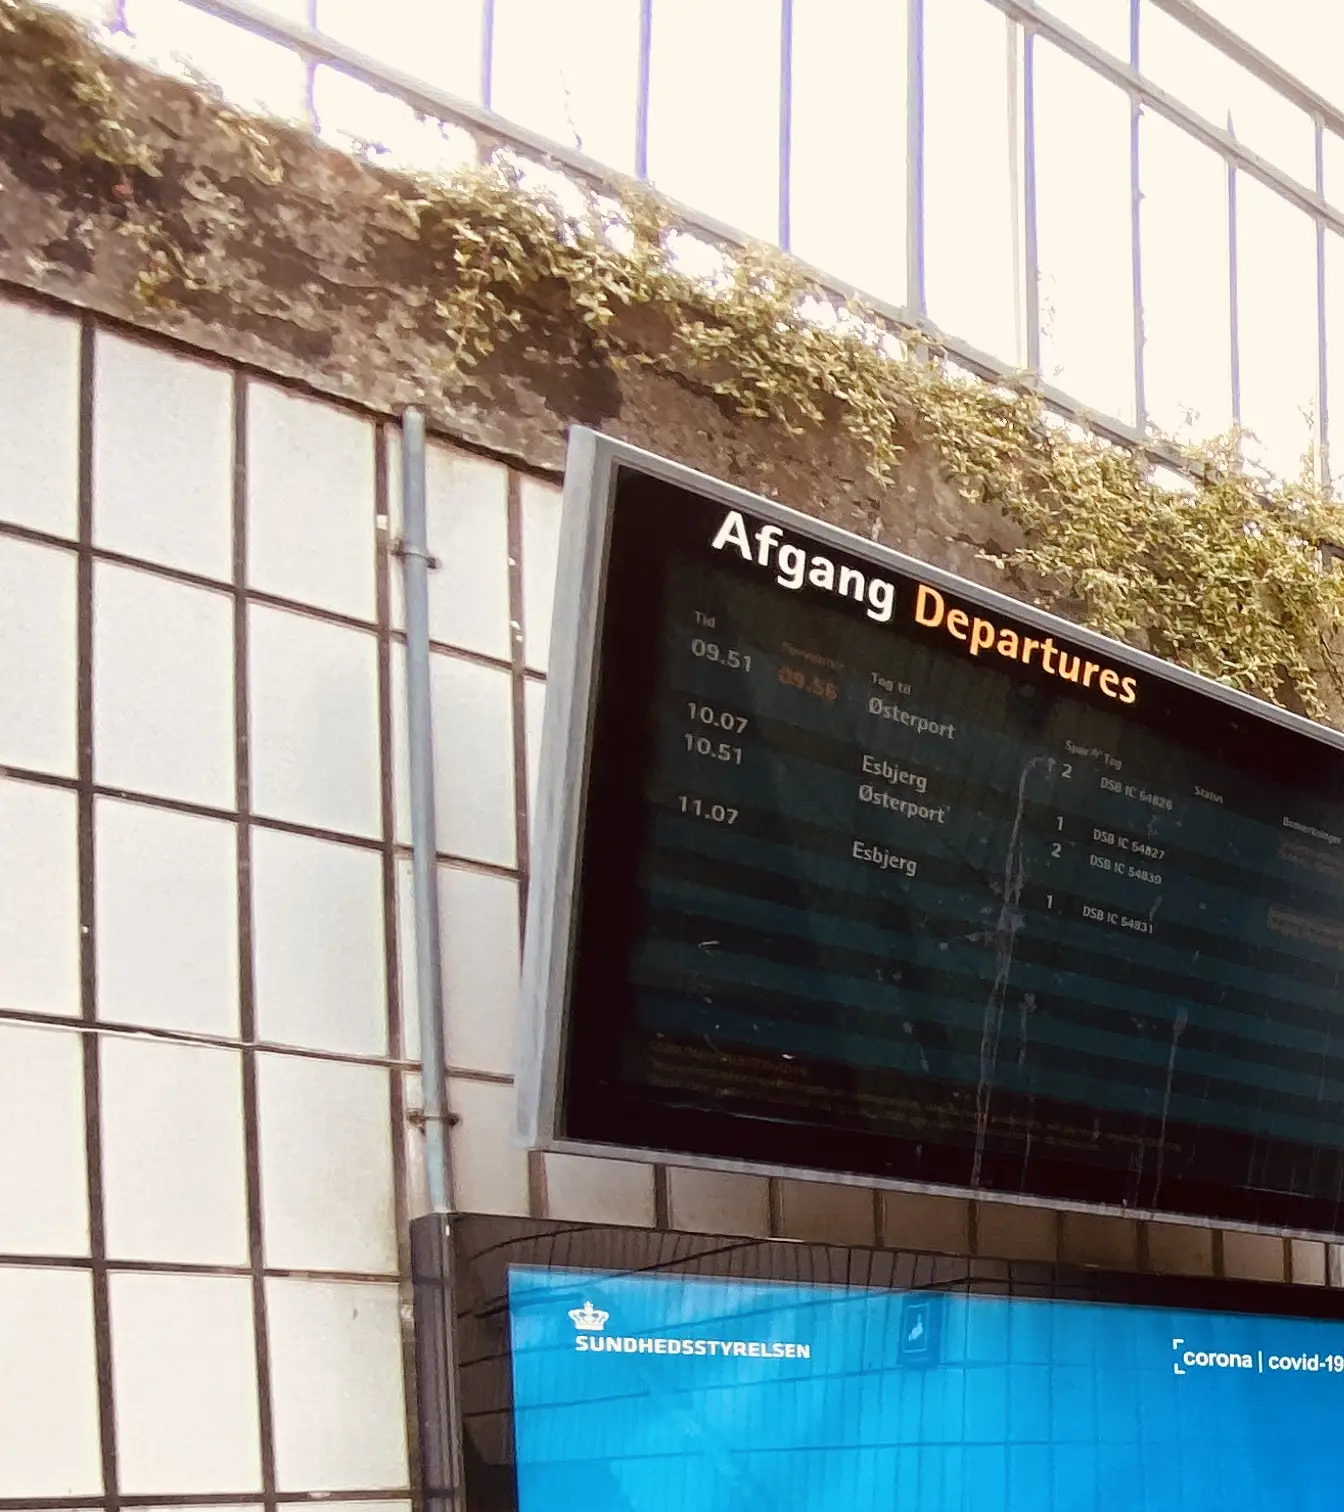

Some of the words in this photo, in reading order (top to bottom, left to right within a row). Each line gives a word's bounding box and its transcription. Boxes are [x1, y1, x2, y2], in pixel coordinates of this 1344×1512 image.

[694, 610, 717, 629] Tid
[711, 510, 895, 621] Afgang
[912, 585, 1139, 705] Departures
[686, 702, 749, 735] 10.07
[862, 753, 928, 794] Esbjerg
[1055, 815, 1064, 832] 1
[1092, 827, 1115, 846] DSB
[1117, 835, 1129, 850] IC
[690, 638, 753, 673] 09.51
[868, 696, 956, 741] Østerport
[1060, 763, 1073, 780] 2
[1125, 785, 1138, 799] IC
[678, 795, 740, 826] 11.07
[851, 839, 918, 878] Esbjerg
[1045, 894, 1054, 910] 1
[1082, 905, 1104, 923] DSB
[1106, 913, 1118, 926] IC
[683, 732, 744, 766] 10.51
[858, 783, 943, 824] Østerport
[1050, 843, 1062, 859] 2
[1089, 853, 1112, 872] DSB
[1114, 861, 1126, 876] IC
[575, 1333, 811, 1360] SUNDHEDSSTYRELSEN
[1182, 1347, 1254, 1370] corona
